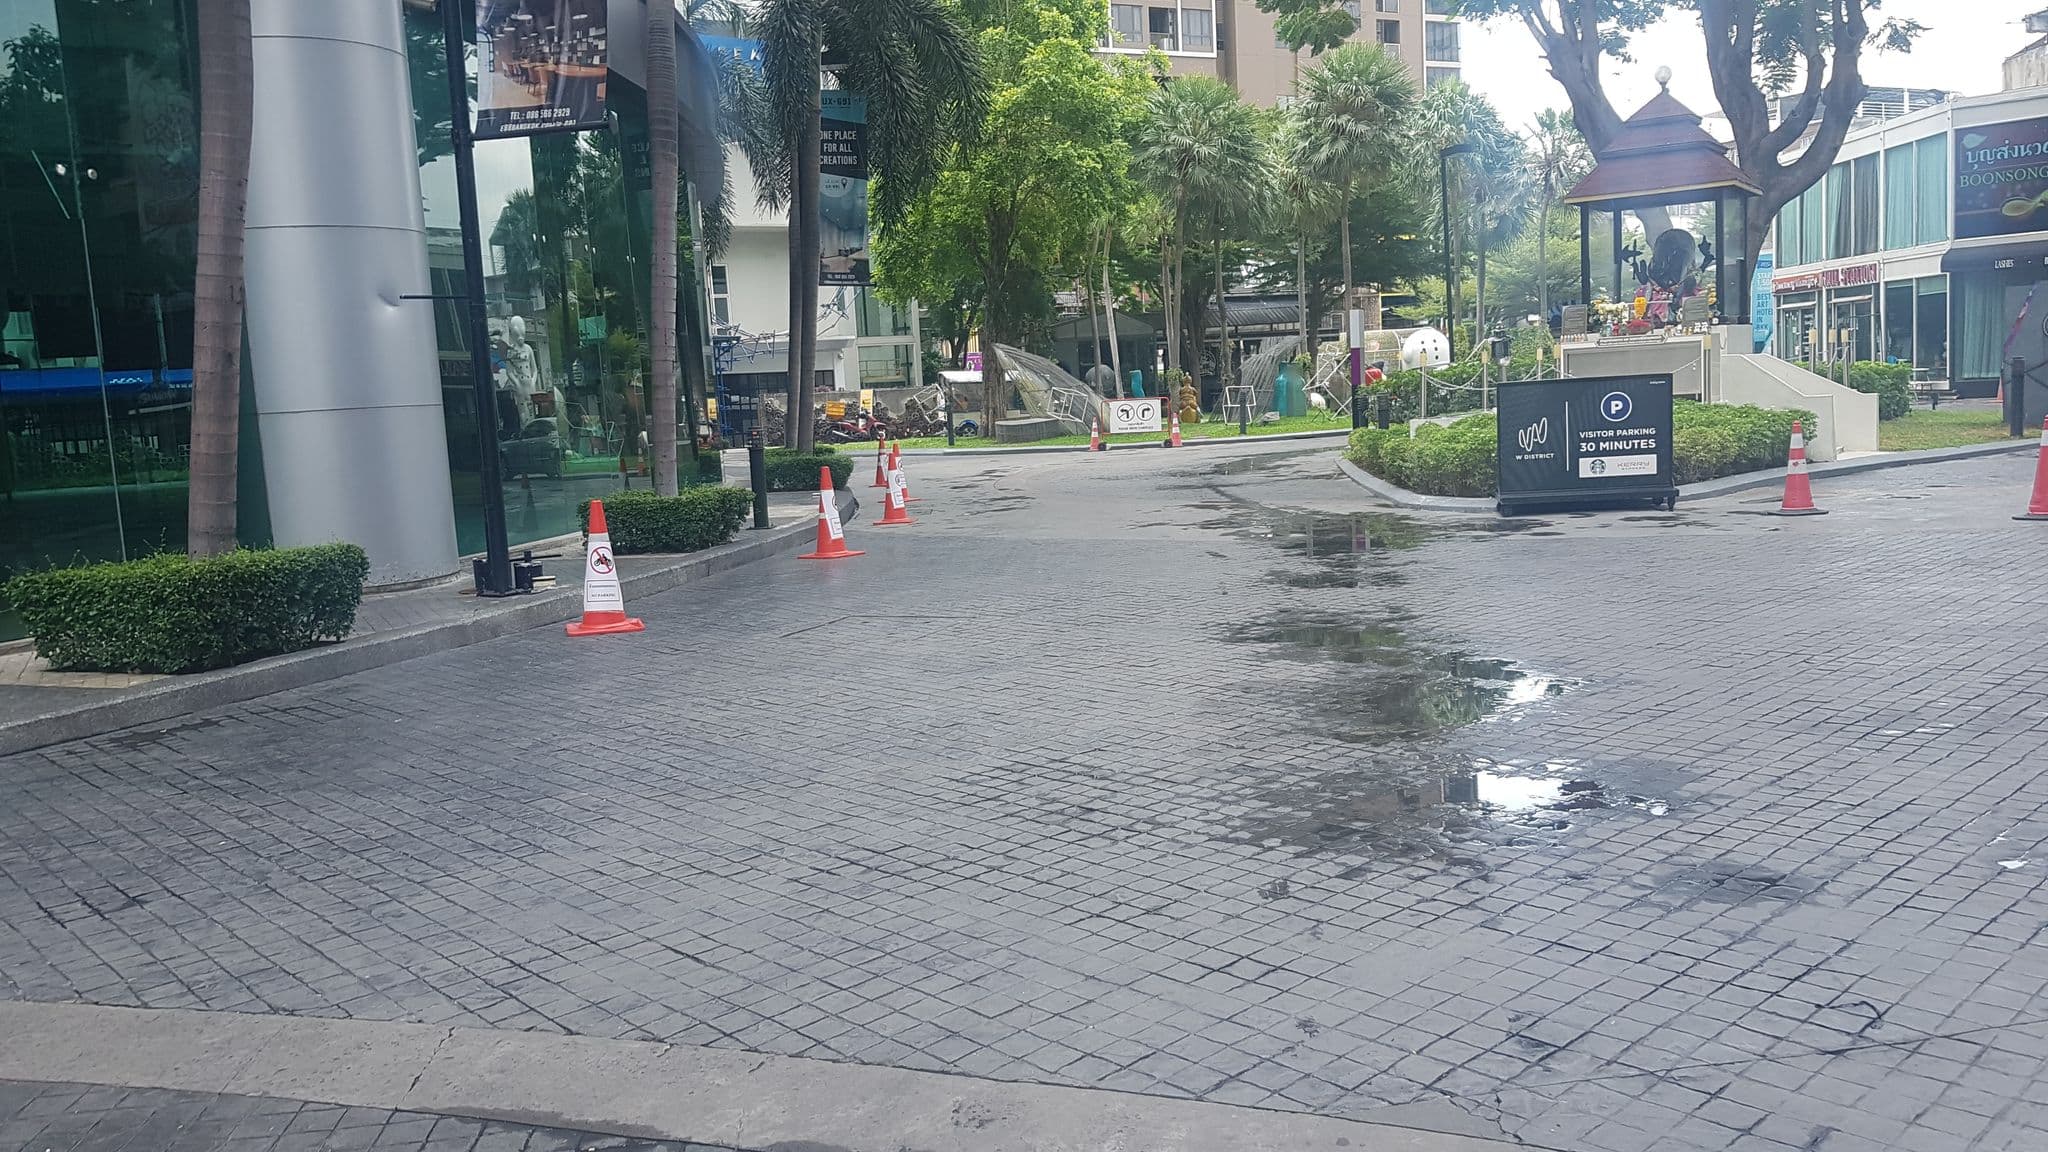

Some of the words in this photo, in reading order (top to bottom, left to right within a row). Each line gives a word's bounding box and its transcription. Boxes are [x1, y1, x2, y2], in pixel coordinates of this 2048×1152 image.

[835, 130, 857, 140] PLACE
[823, 143, 838, 153] FOR
[839, 143, 853, 153] ALL
[819, 155, 858, 165] CREATIONS
[1960, 166, 2048, 188] BOONSONG
[1757, 308, 1773, 316] HOTE
[1610, 400, 1624, 415] P
[1579, 430, 1615, 439] VISITOR
[1616, 427, 1656, 437] PARKING
[1579, 442, 1596, 452] 30
[1599, 439, 1656, 451] MINUTES
